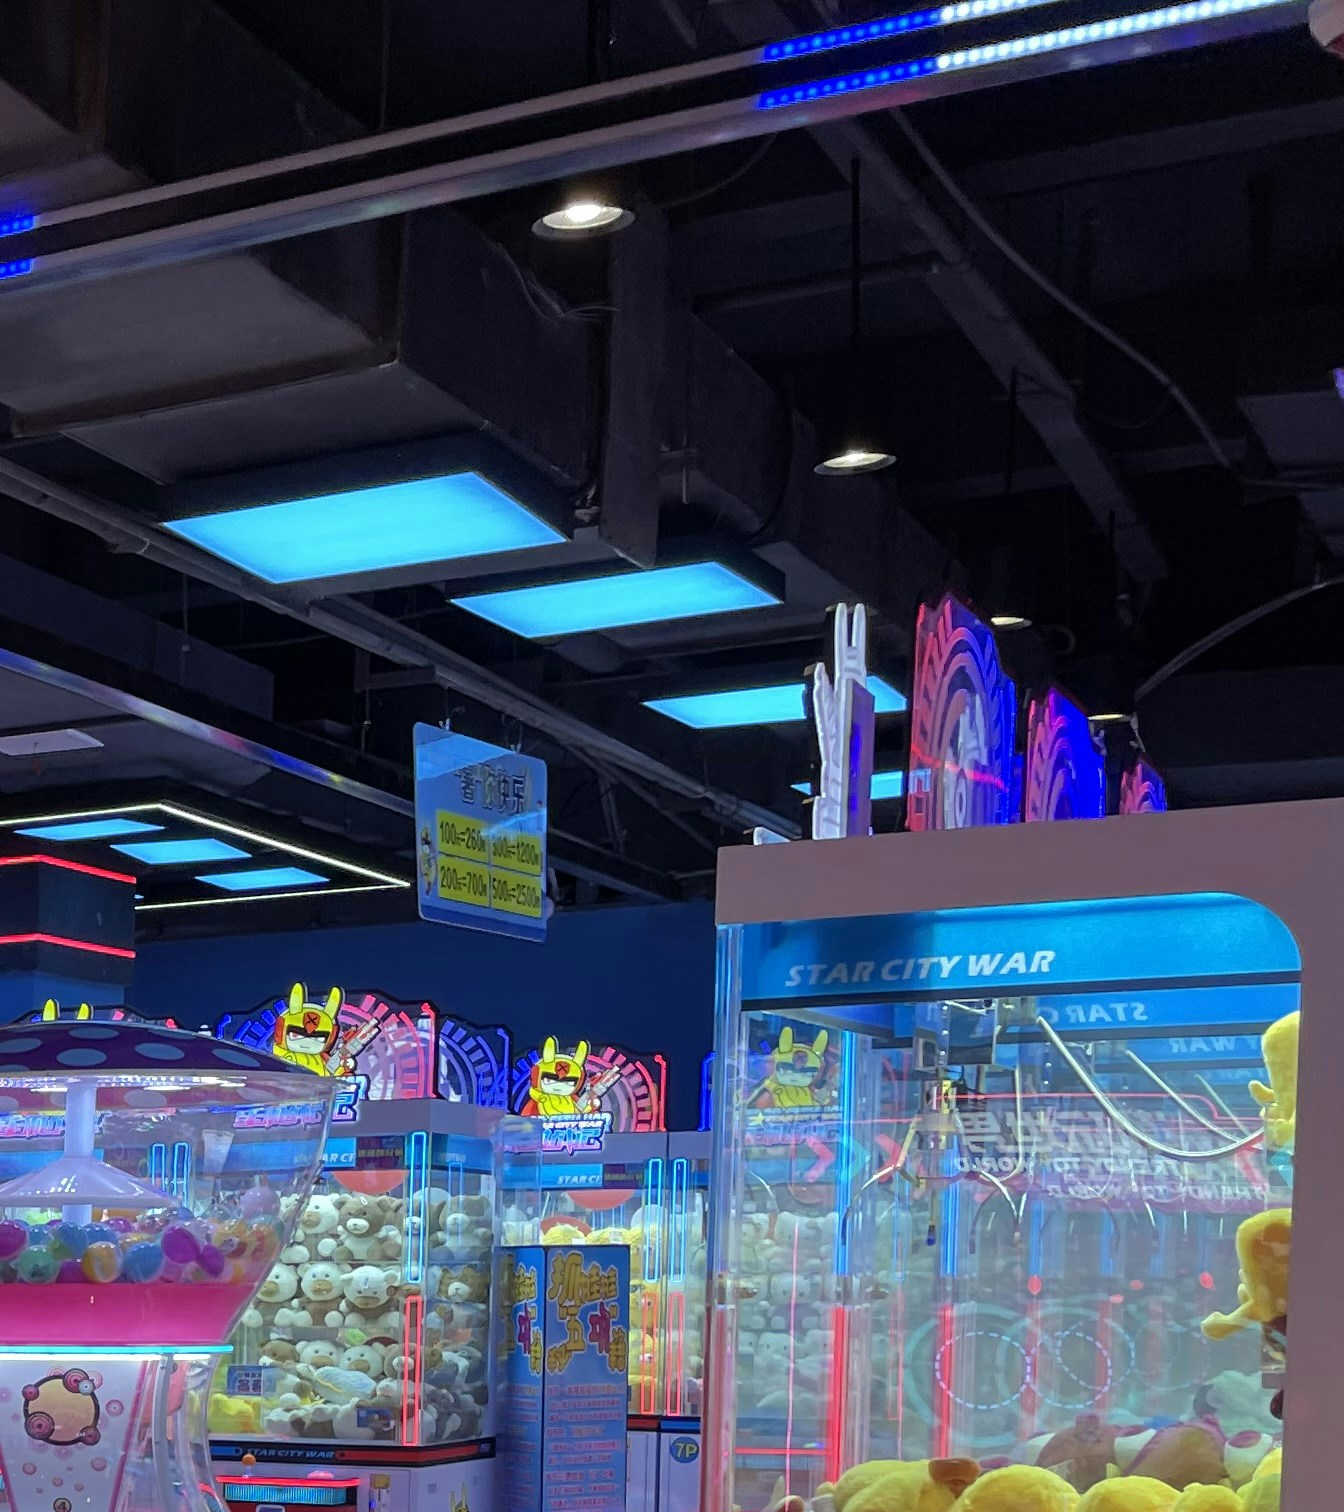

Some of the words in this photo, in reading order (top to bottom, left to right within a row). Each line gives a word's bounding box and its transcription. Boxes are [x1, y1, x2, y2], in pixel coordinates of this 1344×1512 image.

[785, 961, 883, 988] STAR
[886, 956, 962, 982] CITY
[968, 949, 1055, 977] WAR
[675, 1443, 698, 1458] 7P
